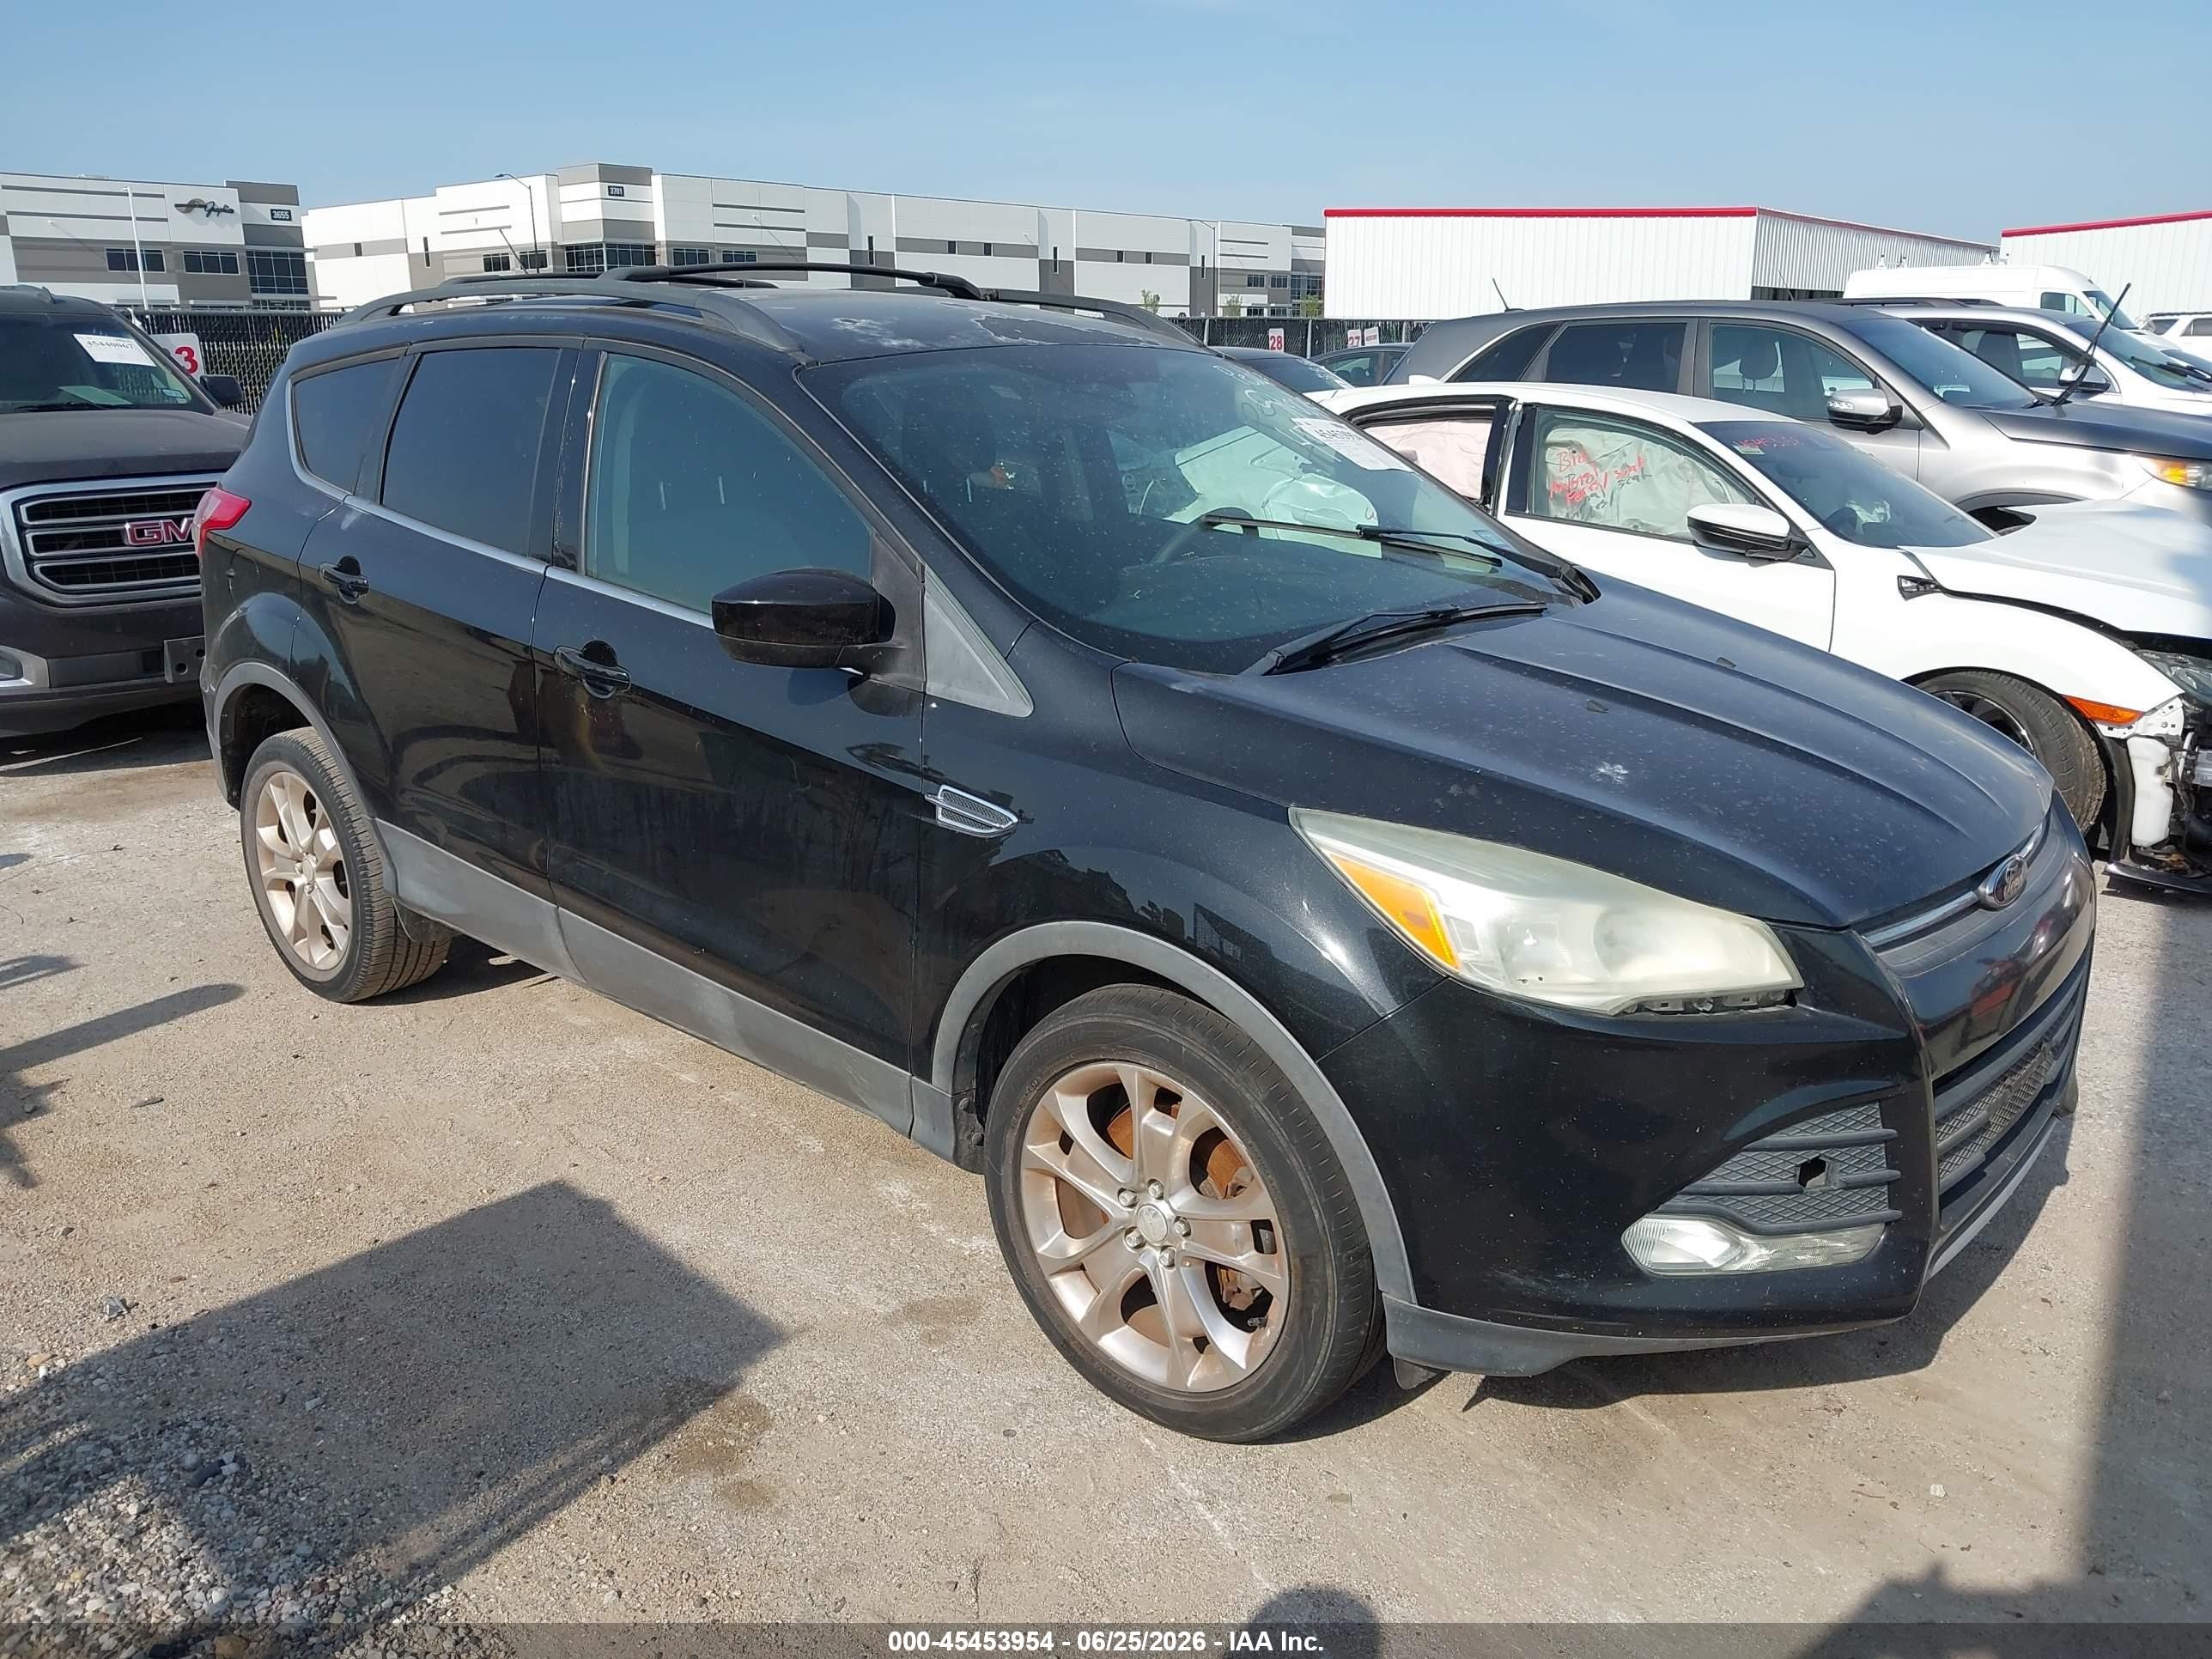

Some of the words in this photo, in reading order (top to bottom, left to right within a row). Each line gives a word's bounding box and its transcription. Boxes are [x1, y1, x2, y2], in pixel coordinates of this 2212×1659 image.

[610, 186, 623, 196] 3701
[271, 210, 290, 220] 3655
[1270, 335, 1283, 350] 28
[125, 518, 194, 547] GM
